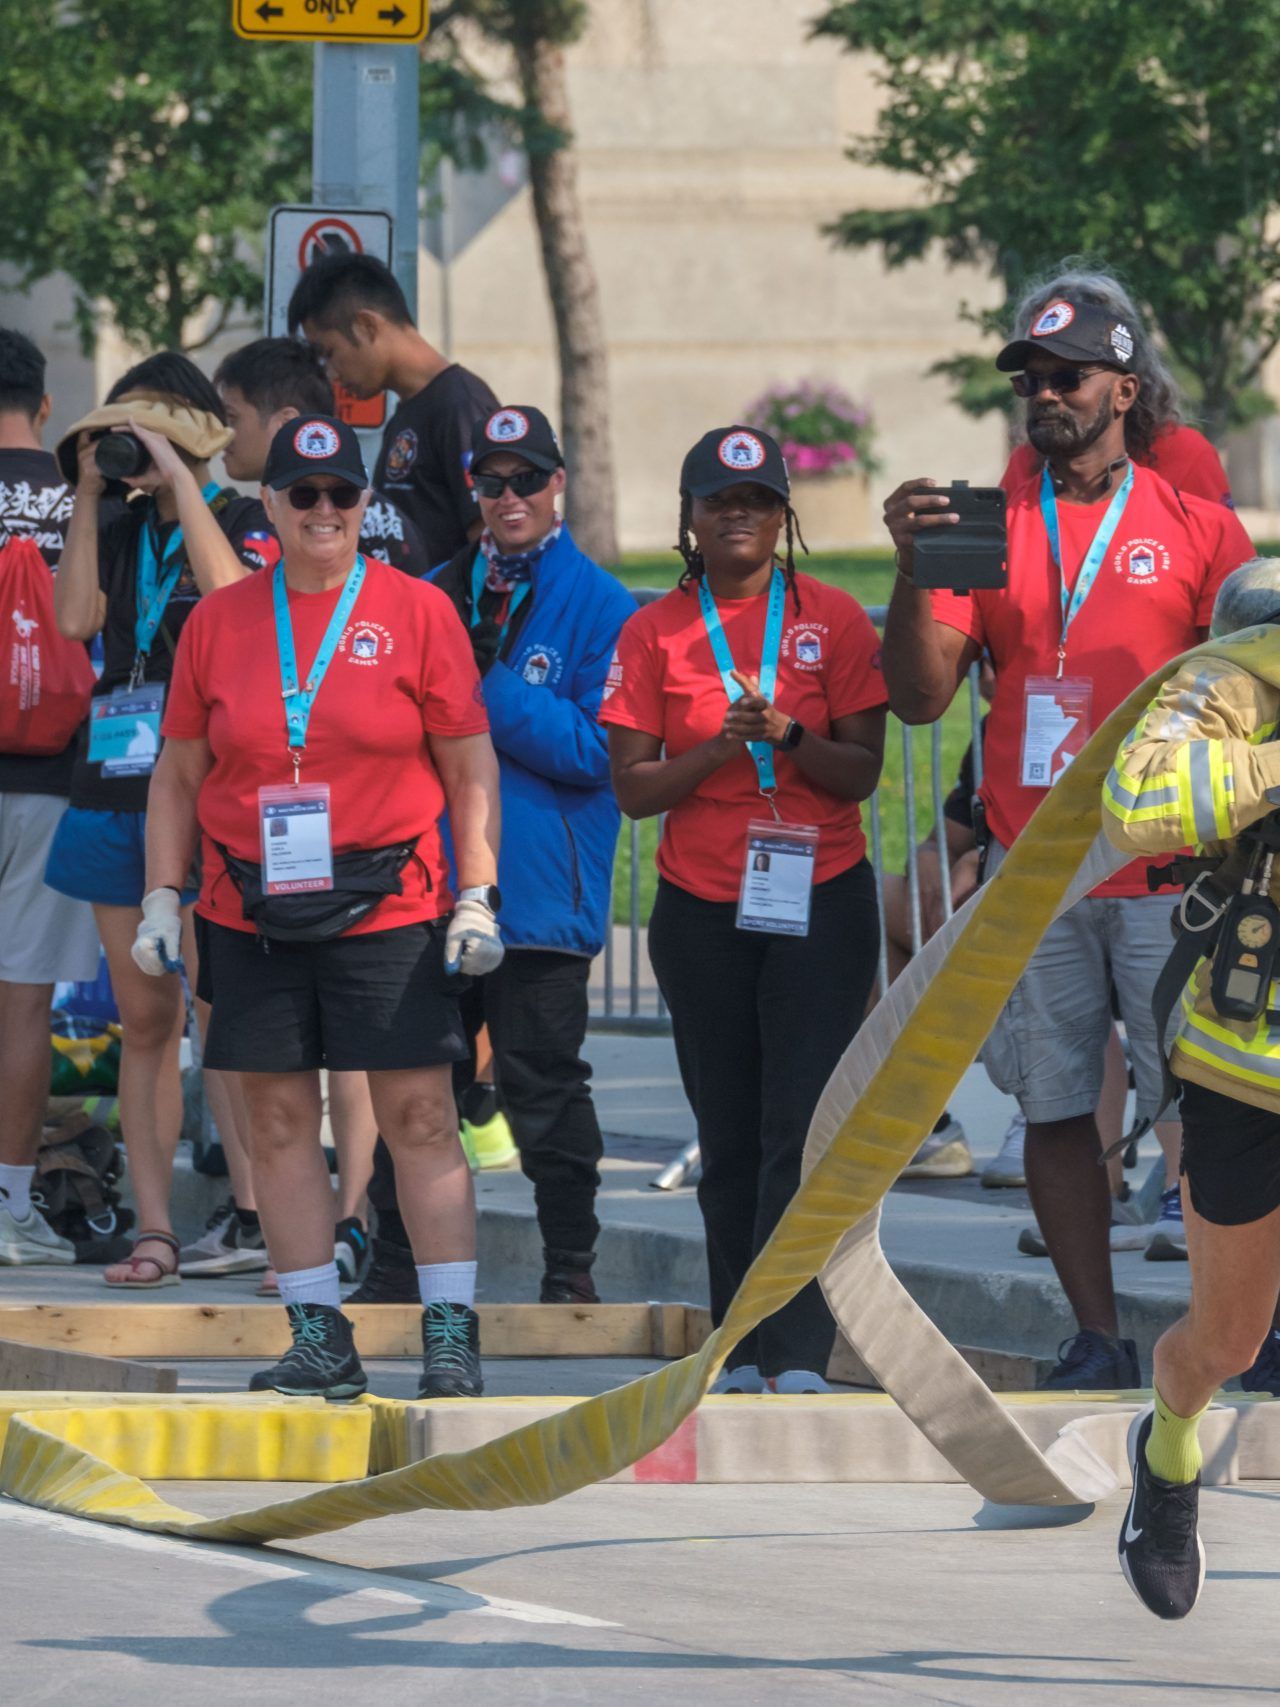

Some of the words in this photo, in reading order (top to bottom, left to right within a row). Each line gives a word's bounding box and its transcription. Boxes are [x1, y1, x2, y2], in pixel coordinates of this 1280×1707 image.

[304, 0, 358, 15] ONLY
[1128, 538, 1158, 547] POLICE
[1127, 576, 1159, 585] GAMES
[274, 879, 325, 891] VOLUNTEER
